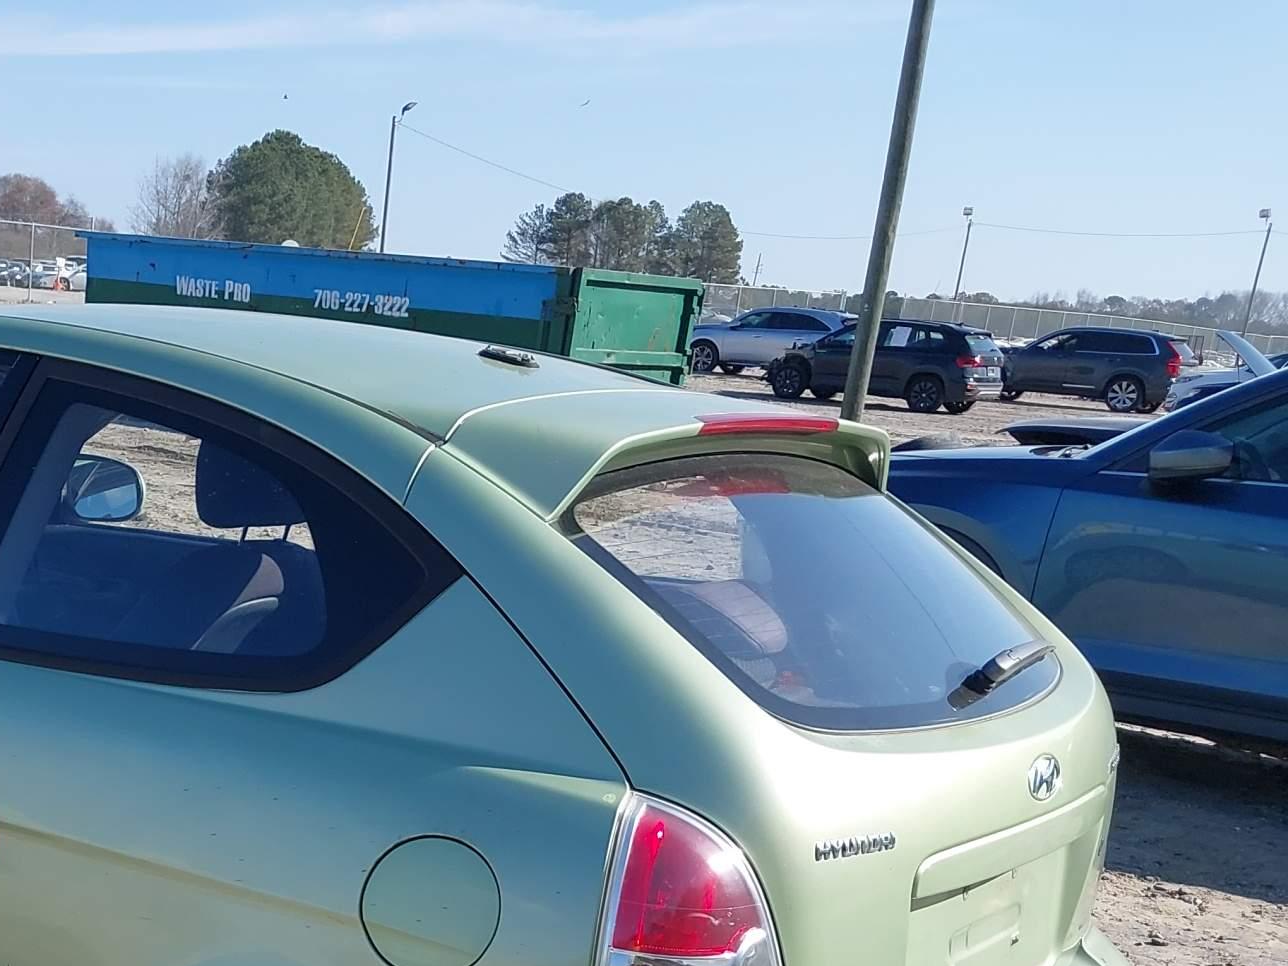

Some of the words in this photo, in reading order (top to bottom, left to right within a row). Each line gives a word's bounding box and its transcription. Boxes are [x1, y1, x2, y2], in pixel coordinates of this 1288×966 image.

[176, 275, 218, 299] WASTE
[224, 280, 250, 303] PRO
[314, 289, 410, 317] 706-227-3222
[814, 832, 896, 862] HYUNDAI
